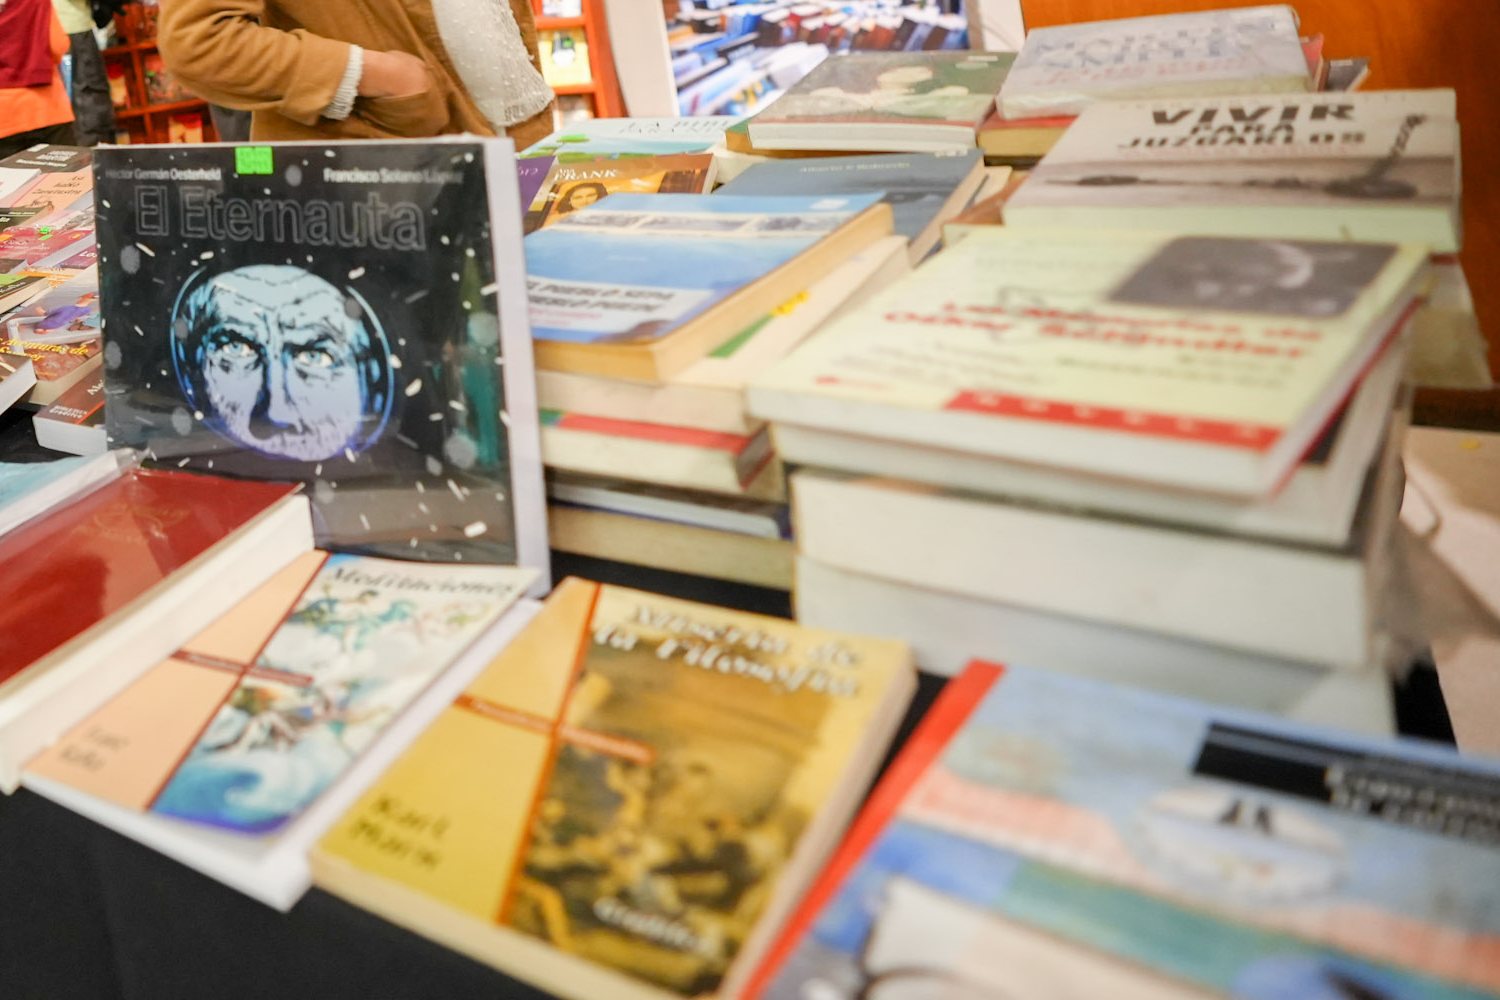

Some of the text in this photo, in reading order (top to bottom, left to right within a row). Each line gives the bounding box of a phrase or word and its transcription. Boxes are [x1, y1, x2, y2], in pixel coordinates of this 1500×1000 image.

[1152, 104, 1355, 126] VIVIR
[134, 166, 169, 182] Germán
[170, 166, 223, 181] Oesterheld
[323, 167, 379, 183] Francisco
[554, 169, 619, 181] FRANK
[134, 184, 428, 251] El Eternauta
[1, 336, 68, 355] Aventuras
[71, 342, 89, 356] de
[334, 567, 514, 595] Meditaciones
[369, 792, 452, 844] Karl
[347, 814, 444, 874] Marx
